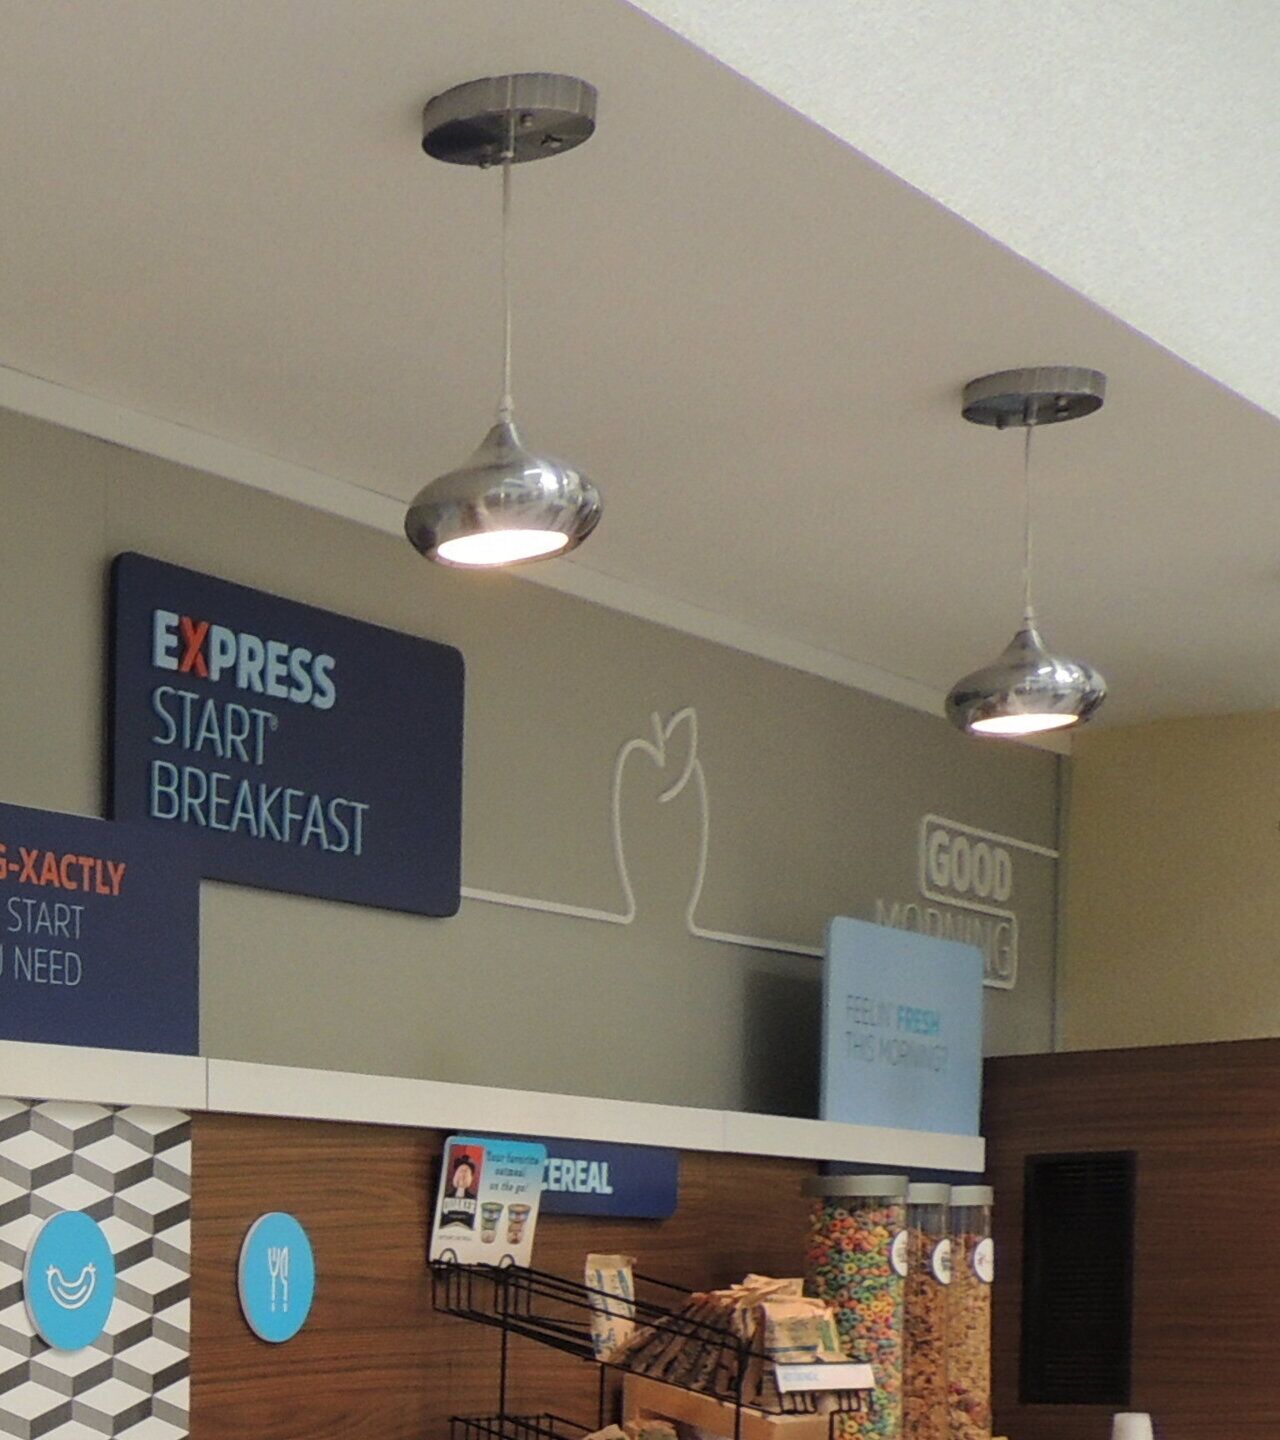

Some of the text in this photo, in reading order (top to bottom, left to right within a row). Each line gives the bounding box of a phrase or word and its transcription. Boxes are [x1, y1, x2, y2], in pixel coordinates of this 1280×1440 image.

[152, 609, 336, 710] EXPRESS
[150, 760, 369, 856] BREAKFAST
[929, 829, 1013, 902] GOOD
[6, 898, 85, 940] START
[14, 945, 82, 987] NEED
[896, 1005, 941, 1035] FRESH
[845, 1030, 875, 1063] THIS
